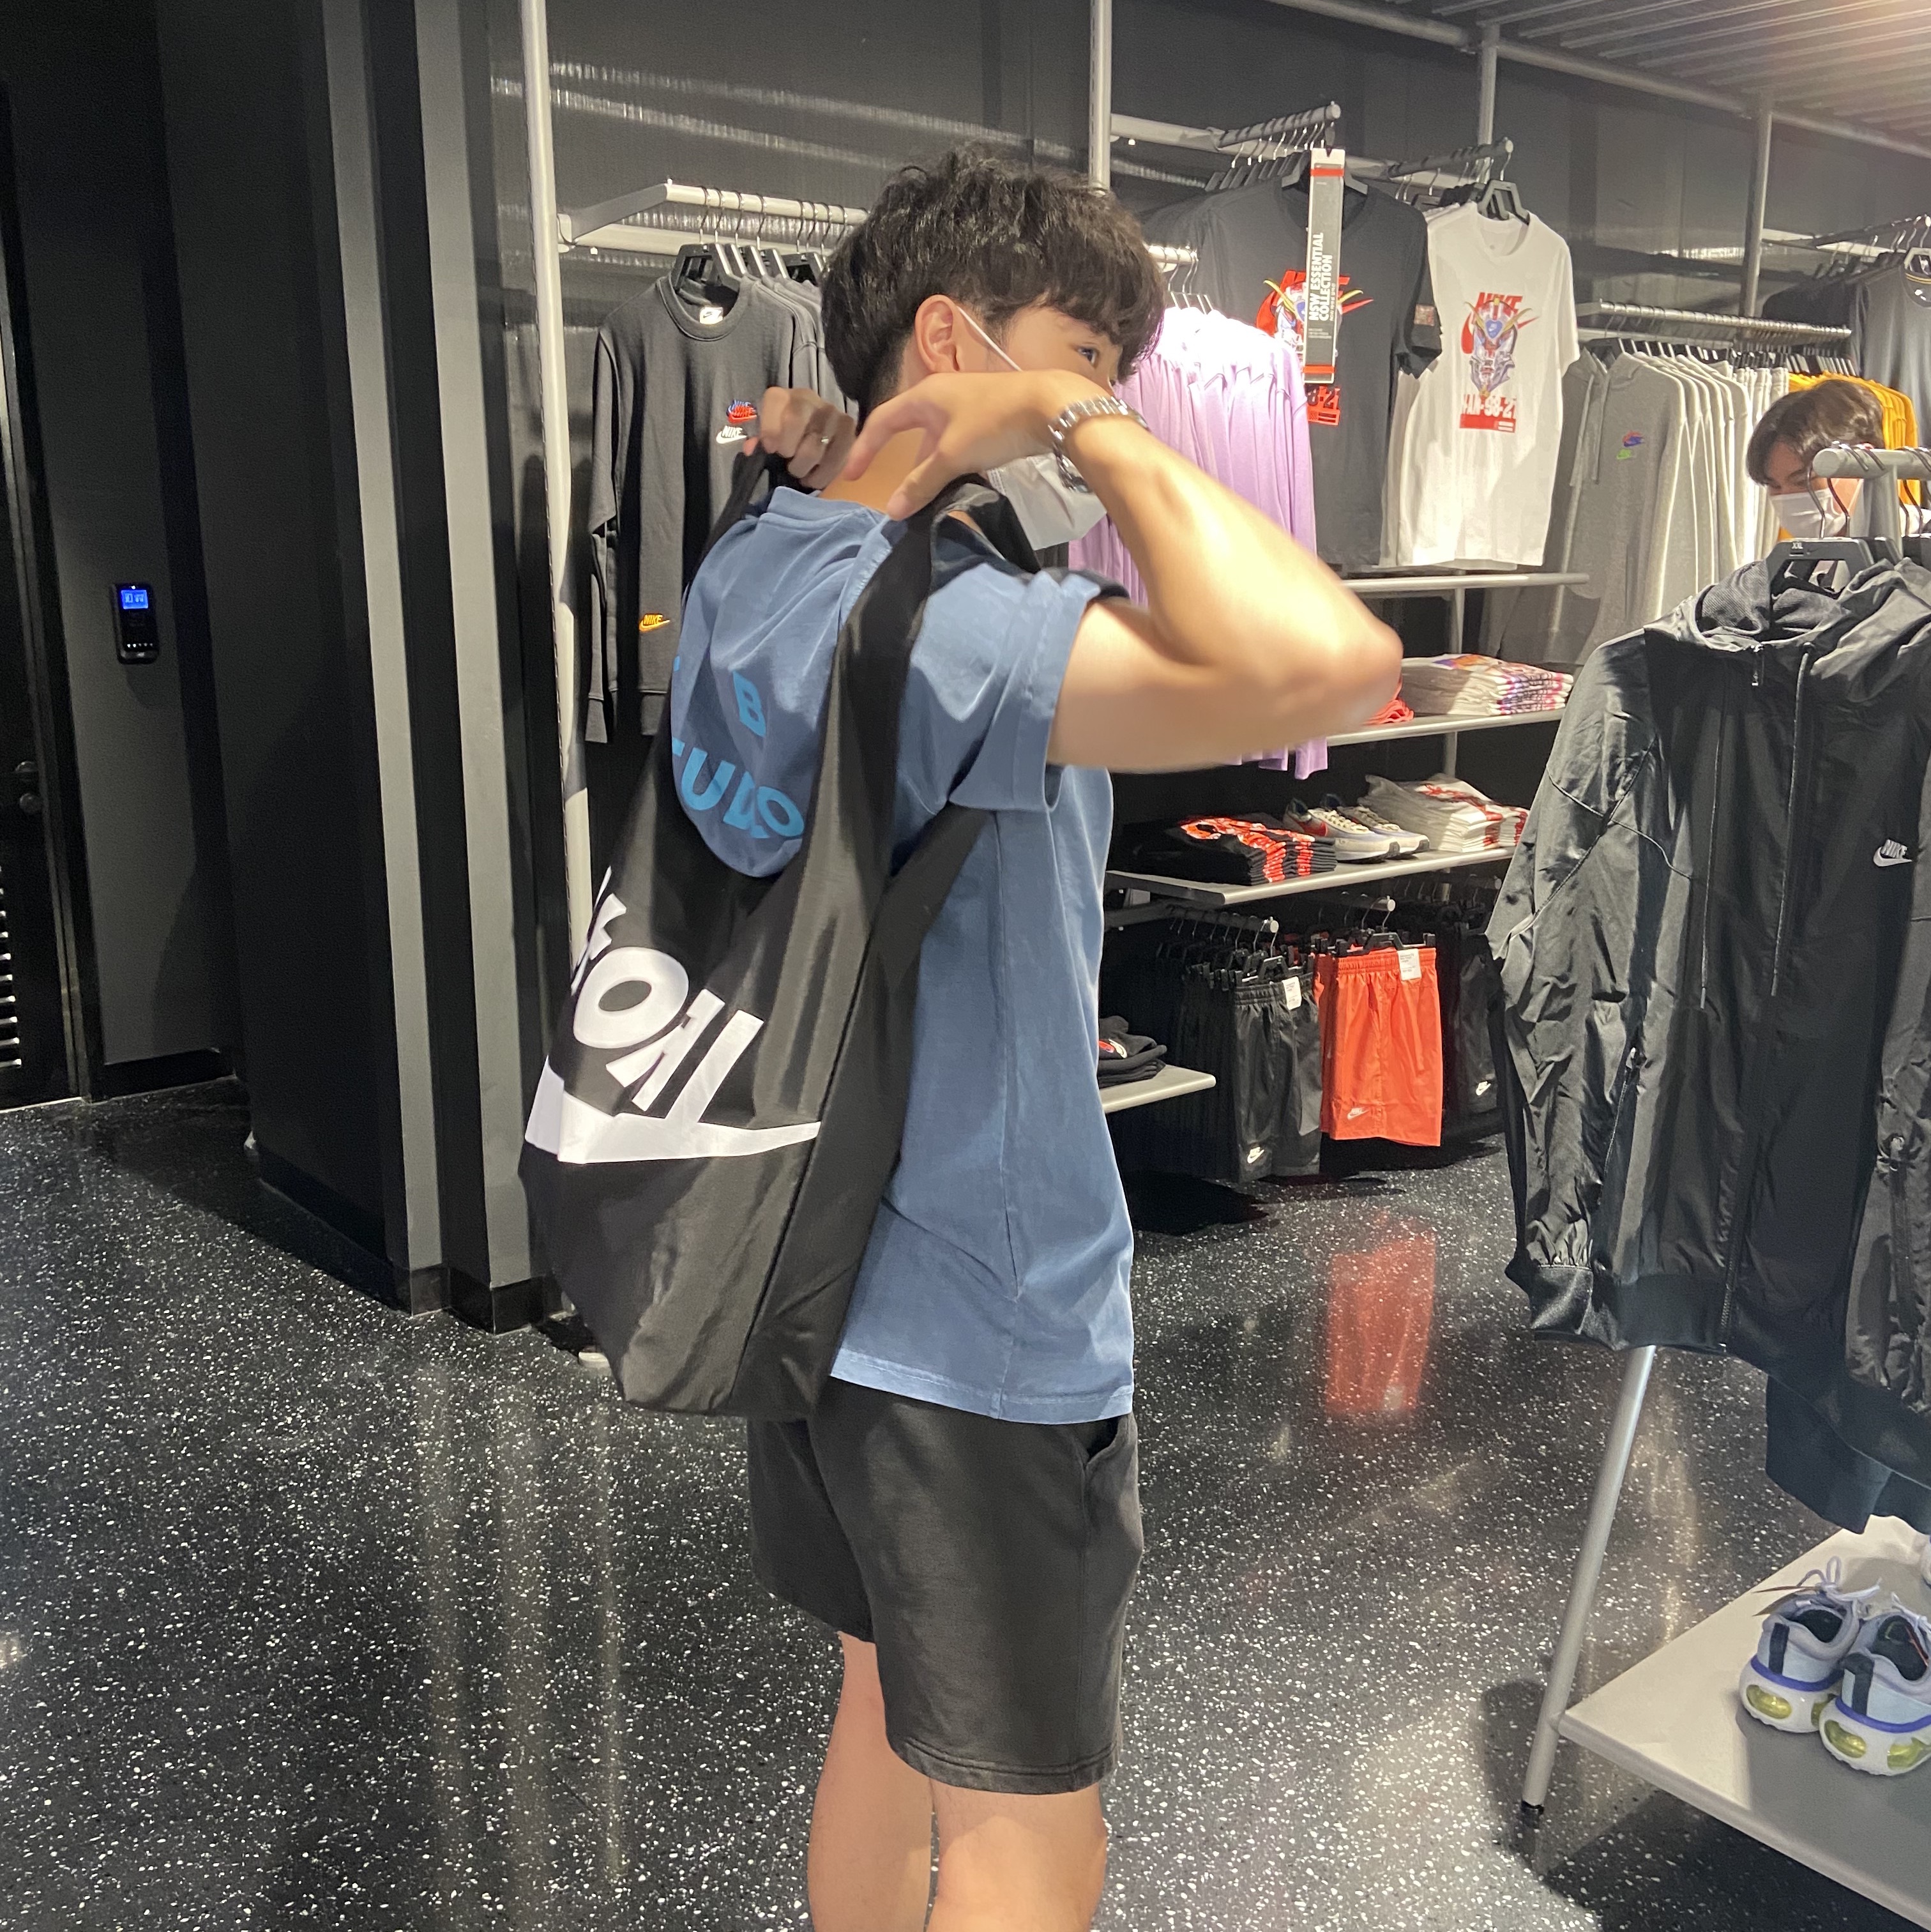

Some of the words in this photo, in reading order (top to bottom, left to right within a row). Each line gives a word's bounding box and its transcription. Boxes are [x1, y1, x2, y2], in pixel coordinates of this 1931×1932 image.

[1310, 232, 1324, 290] ESSENTIAL
[1319, 255, 1333, 321] COLLECTION
[1309, 293, 1321, 321] NSW
[721, 425, 743, 438] NIKE
[643, 614, 663, 625] NIKE
[1881, 839, 1907, 858] NIKE
